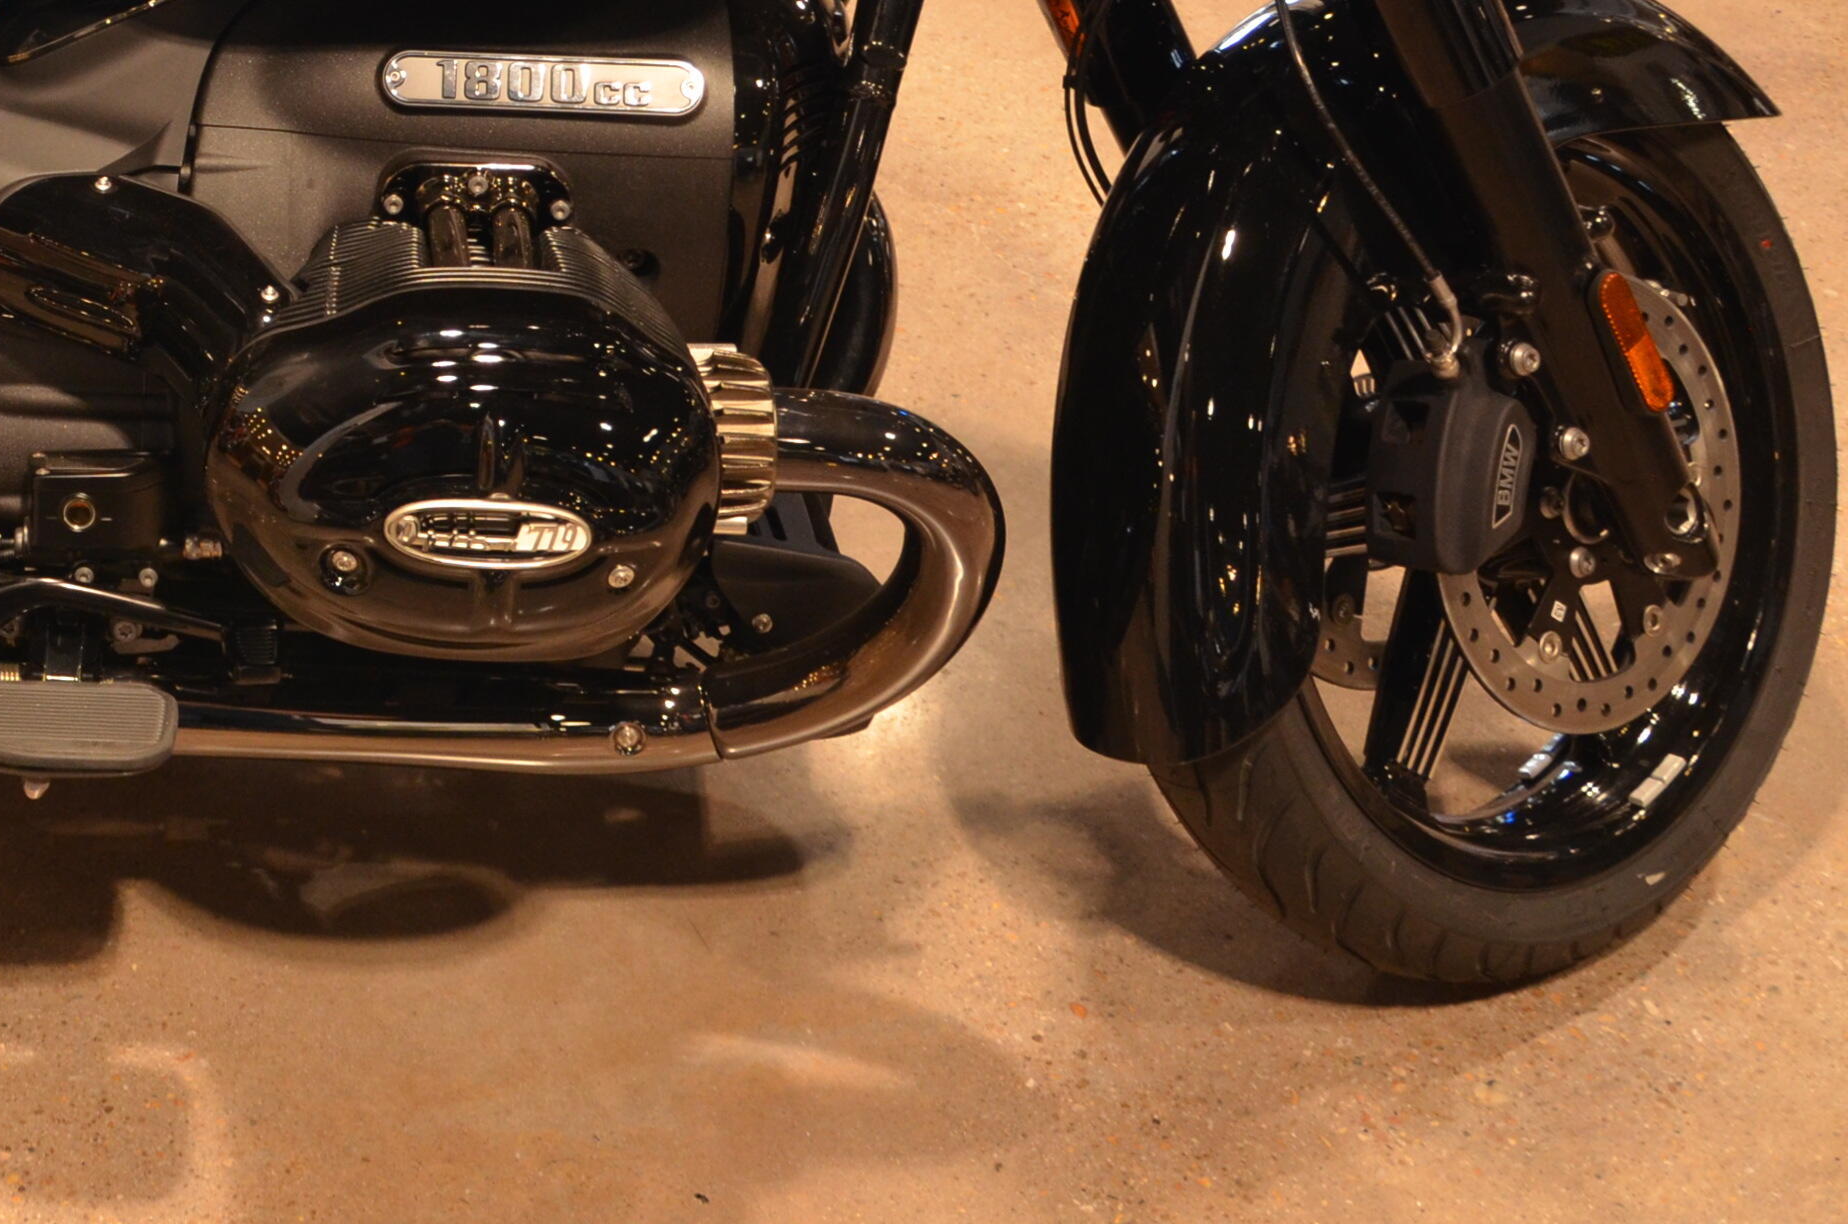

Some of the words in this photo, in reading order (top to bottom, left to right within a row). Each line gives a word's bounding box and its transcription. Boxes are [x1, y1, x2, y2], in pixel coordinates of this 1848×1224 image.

[436, 58, 653, 107] 1800cc
[1496, 443, 1519, 505] BMW
[528, 522, 579, 552] 719
